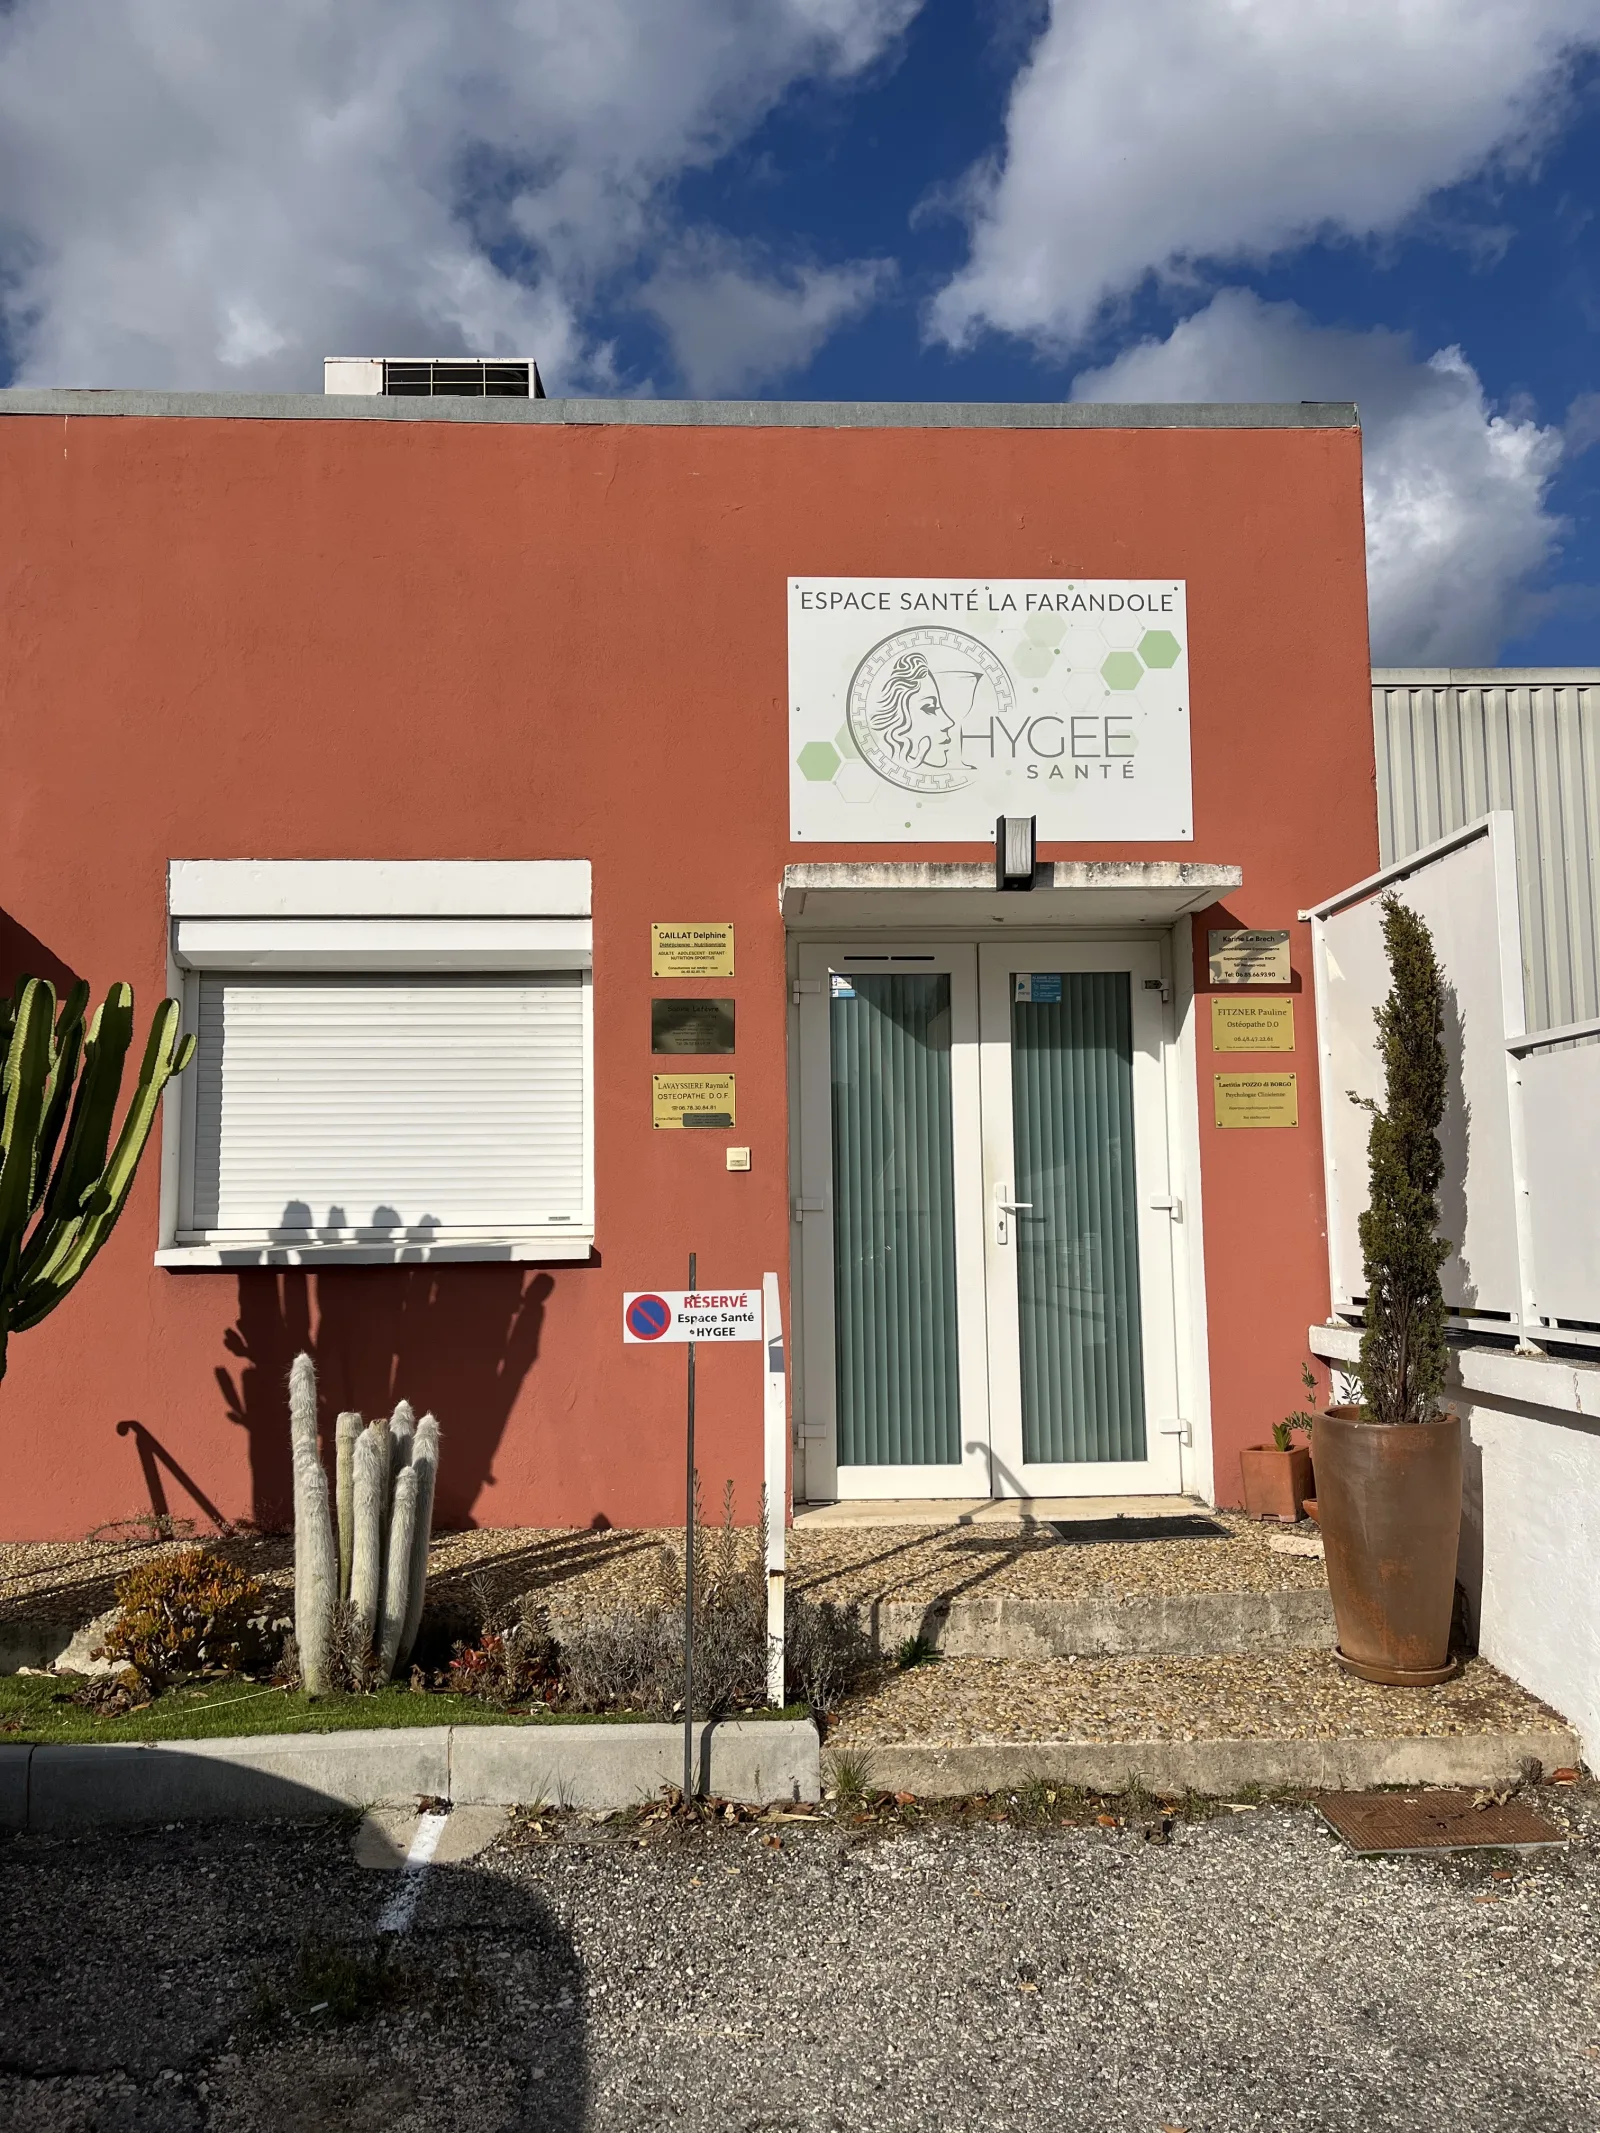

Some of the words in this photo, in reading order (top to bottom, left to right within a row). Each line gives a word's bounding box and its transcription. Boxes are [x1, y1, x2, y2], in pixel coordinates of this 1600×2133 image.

[801, 591, 891, 611] ESPACE
[900, 588, 979, 612] SANTÉ
[988, 594, 1017, 612] LA
[1025, 593, 1174, 612] FARANDOLE
[960, 715, 1135, 759] HYGEE
[1026, 760, 1135, 780] SANTÉ
[693, 931, 726, 940] Delphine
[1217, 1008, 1256, 1016] FITZNER
[1258, 1008, 1287, 1016] Pauline
[1226, 1021, 1266, 1029] Ostéopathe
[705, 1082, 729, 1090] Raynald
[683, 1293, 748, 1309] RÉSERVÉ
[677, 1313, 718, 1324] Espace
[720, 1312, 755, 1323] Santé
[696, 1327, 736, 1337] HYGEE
